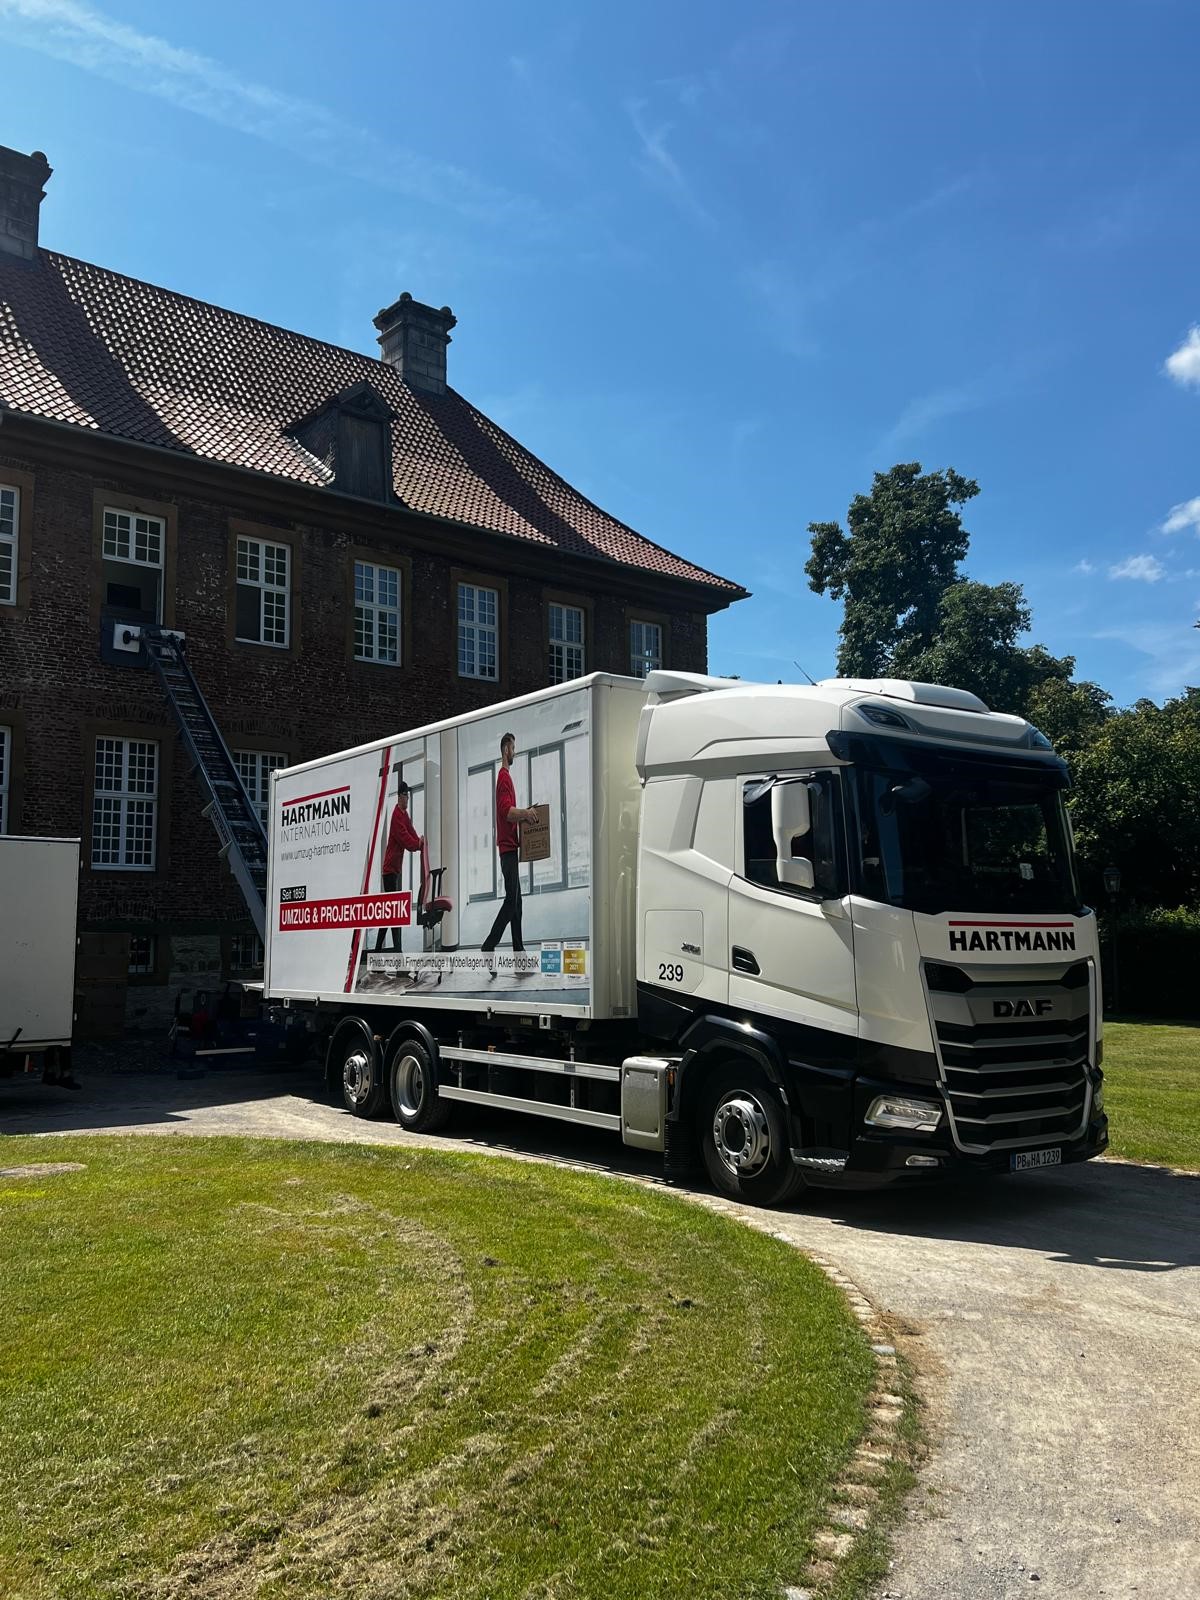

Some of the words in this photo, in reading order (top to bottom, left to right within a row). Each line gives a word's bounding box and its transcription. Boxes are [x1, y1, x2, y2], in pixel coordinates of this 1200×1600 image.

[281, 794, 350, 827] HARTMANN
[281, 817, 350, 843] INTERNATIONAL
[281, 840, 350, 861] www.umzug-hartmann.de
[281, 889, 292, 900] Seit
[281, 907, 311, 925] UMZUG
[312, 906, 319, 923] &
[320, 899, 409, 923] PROJEKTLOGISTIK
[948, 931, 1076, 951] HARTMANN
[369, 956, 402, 970] Privatumzüge
[405, 956, 446, 970] Firmenumzüge
[449, 956, 494, 970] Möbellagerung
[498, 956, 540, 970] Aktenlogistik
[658, 963, 684, 982] 239
[993, 1000, 1053, 1017] DAF
[1016, 1155, 1027, 1169] PB
[1031, 1152, 1041, 1166] HA
[1042, 1150, 1060, 1164] 1239
